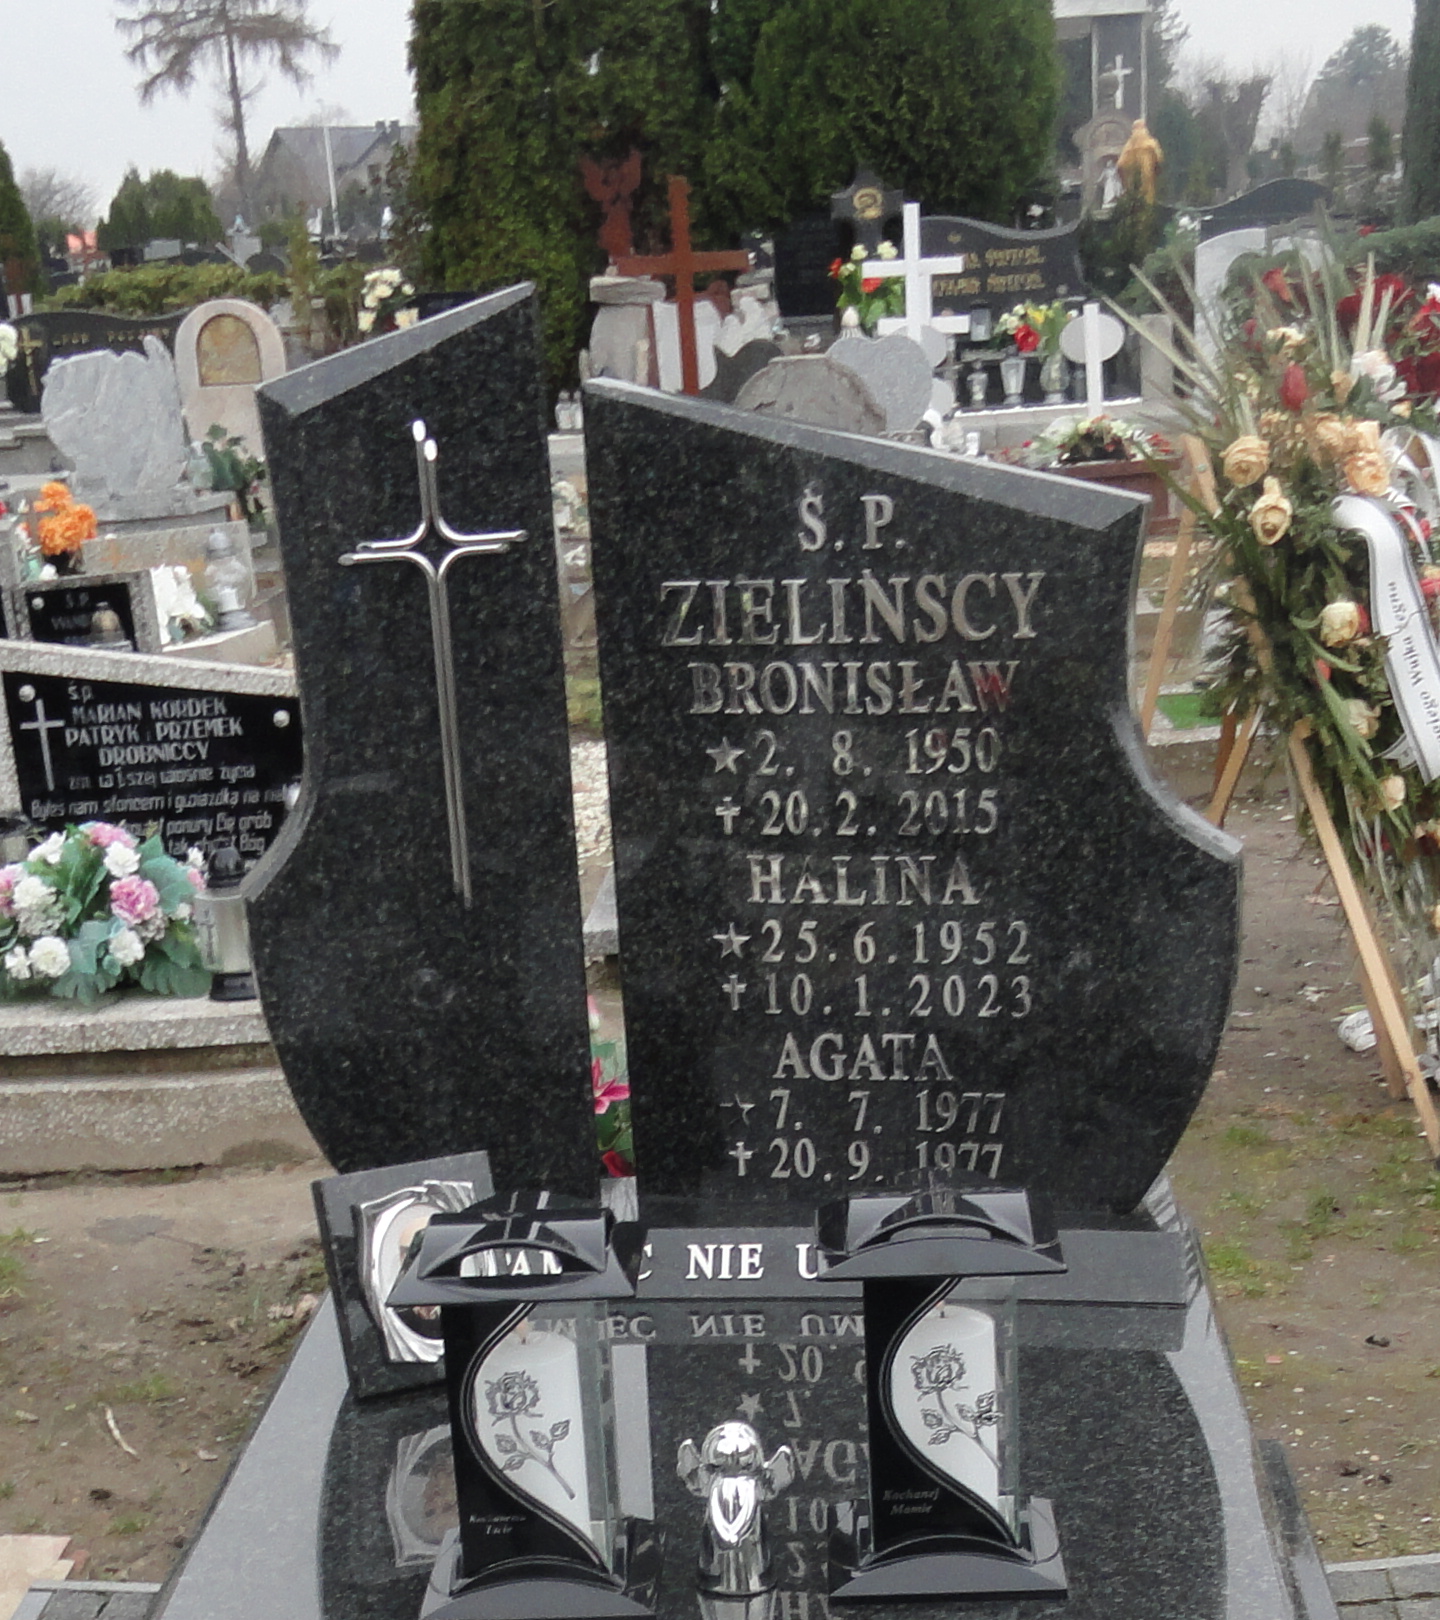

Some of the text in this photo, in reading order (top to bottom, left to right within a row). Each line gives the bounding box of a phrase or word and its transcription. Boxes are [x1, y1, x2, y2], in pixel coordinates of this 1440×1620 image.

[860, 493, 907, 550] P.
[661, 569, 1046, 647] ZIELIŃSCY
[1402, 636, 1426, 687] Wujka
[71, 697, 228, 725] MARIAN KORDEK
[687, 659, 1020, 716] BRONISŁAW
[64, 724, 140, 748] PATRYK
[155, 716, 244, 741] PRZEMEK
[98, 741, 211, 768] DROBNICCY
[747, 854, 982, 907] HALINA
[772, 1031, 954, 1082] AGATA
[685, 1243, 765, 1281] NIE
